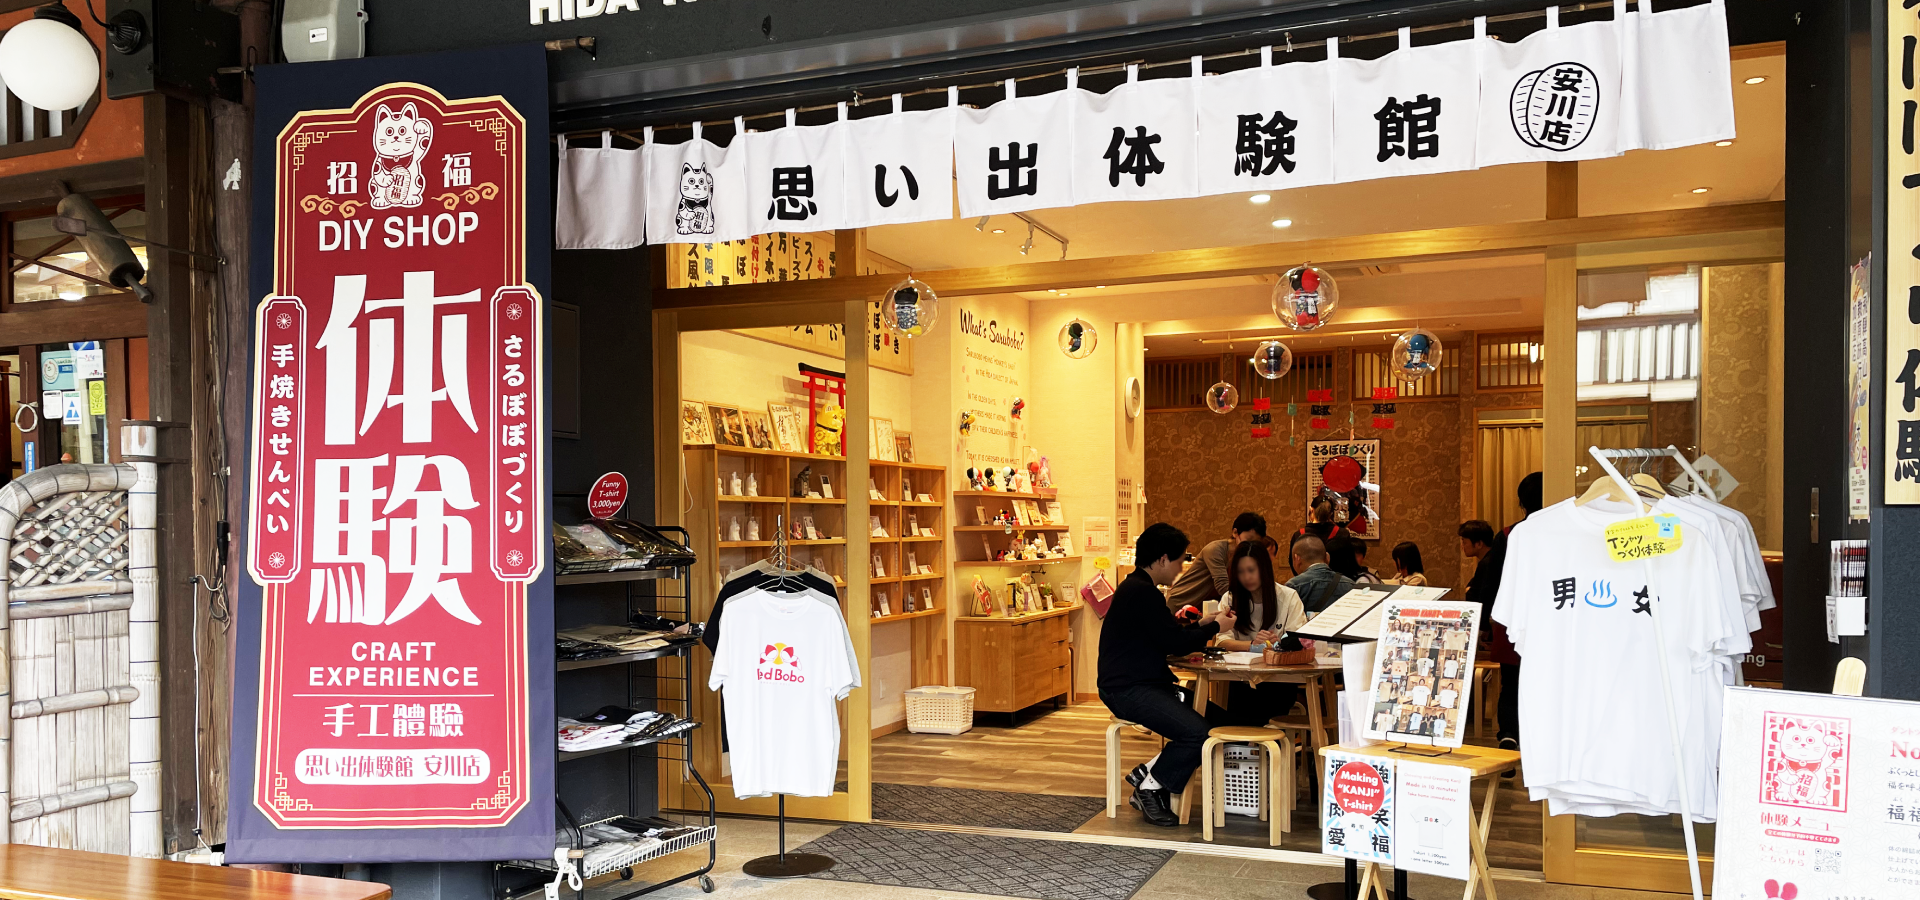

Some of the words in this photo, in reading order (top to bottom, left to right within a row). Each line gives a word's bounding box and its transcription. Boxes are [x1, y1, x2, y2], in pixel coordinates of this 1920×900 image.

[1538, 66, 1586, 147] 安川店
[767, 94, 1442, 222] 思い出体験館
[327, 161, 358, 194] 招
[441, 152, 472, 188] 福
[319, 218, 374, 251] DIY
[383, 211, 479, 249] SHOP
[960, 307, 987, 339] What's
[266, 343, 295, 534] 手焼きせんべい
[502, 334, 527, 534] さるぼぼづくり
[306, 270, 482, 627] 体験
[599, 489, 620, 498] T-shirt
[601, 480, 621, 489] Funny
[592, 499, 621, 509] 3,000yen
[1607, 535, 1643, 550] Tシャツ
[1617, 541, 1666, 559] づくり体験
[351, 641, 437, 663] CRAFT
[308, 666, 479, 687] EXPERIENCE
[774, 668, 805, 683] Bobo
[322, 702, 465, 739] 手工體驗
[304, 754, 414, 779] 思い出体験館
[425, 754, 481, 778] 安川店
[1340, 770, 1379, 786] Making
[1796, 773, 1813, 798] 招福
[1342, 798, 1374, 811] T-shirt
[1760, 812, 1847, 831] 体験メニュー
[1328, 827, 1346, 847] 愛
[1371, 834, 1390, 854] 福
